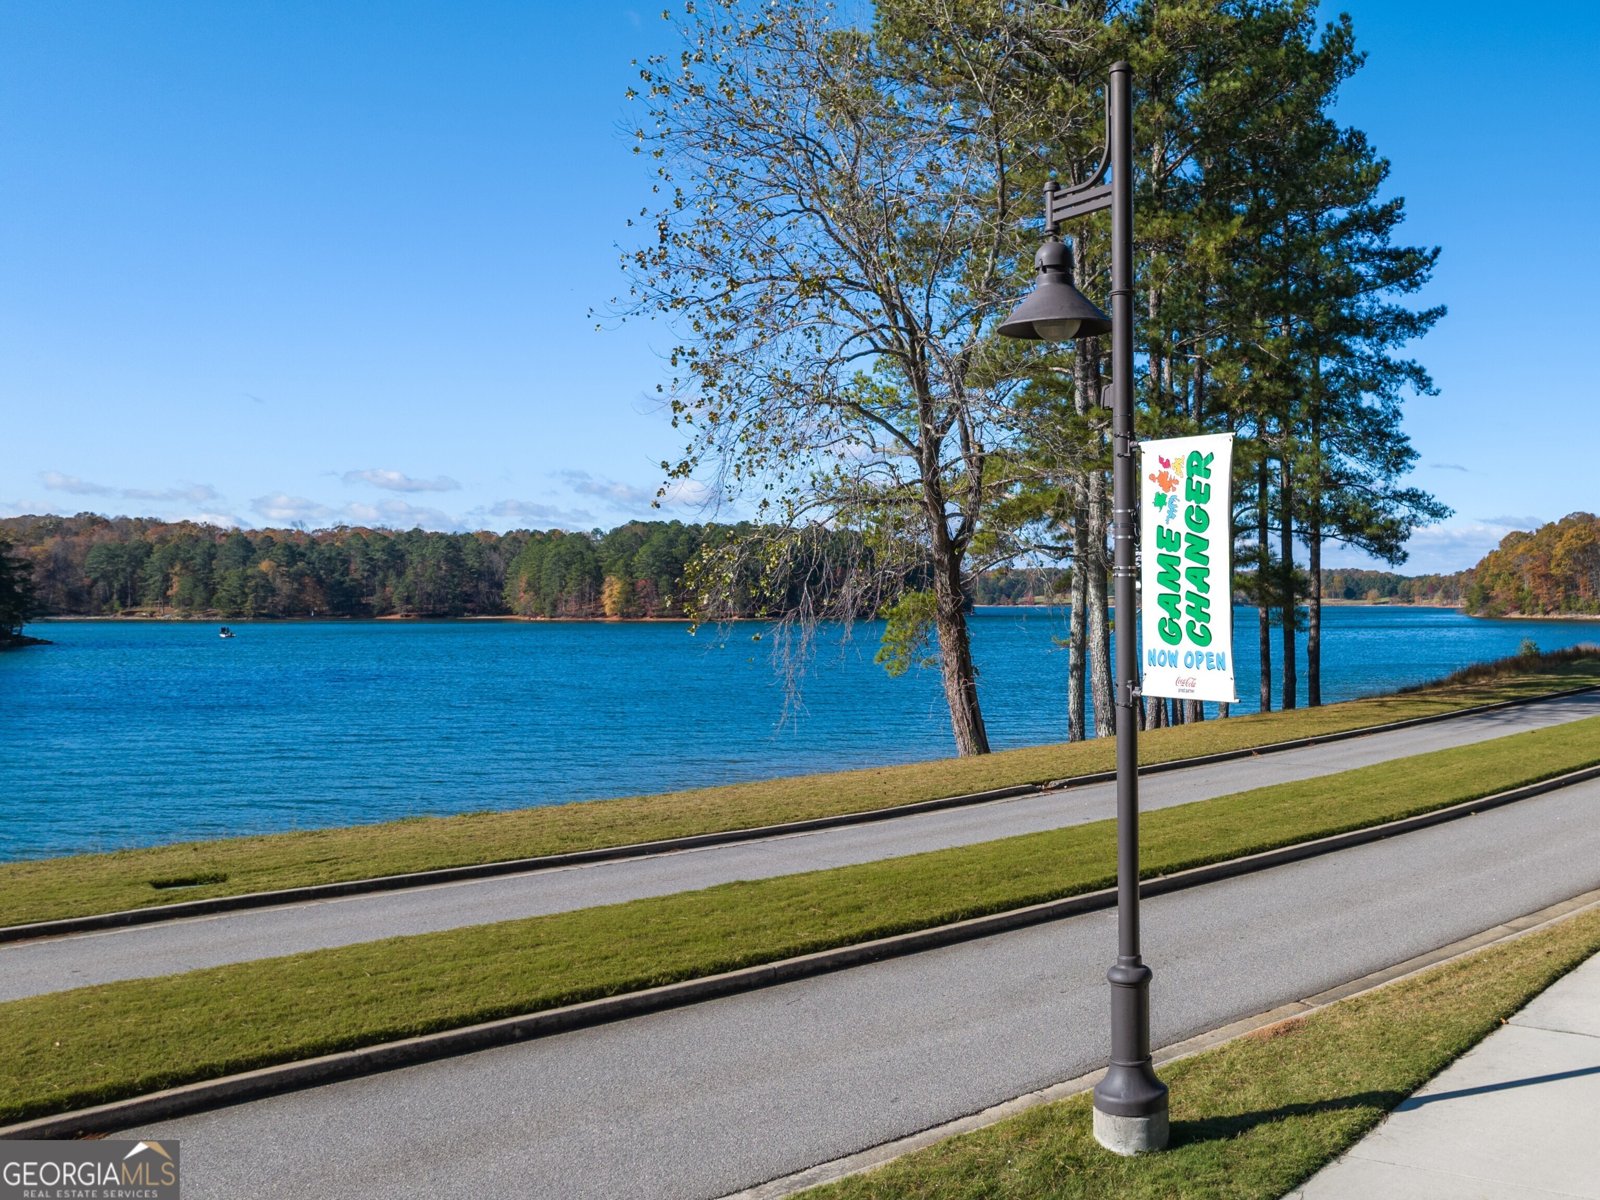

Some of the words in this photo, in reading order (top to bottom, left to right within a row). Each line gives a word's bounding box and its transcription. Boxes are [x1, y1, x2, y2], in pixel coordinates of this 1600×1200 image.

[1156, 525, 1182, 646] GAME
[1184, 450, 1214, 647] CHANGER
[1148, 648, 1179, 668] NOW
[1184, 651, 1226, 671] OPEN
